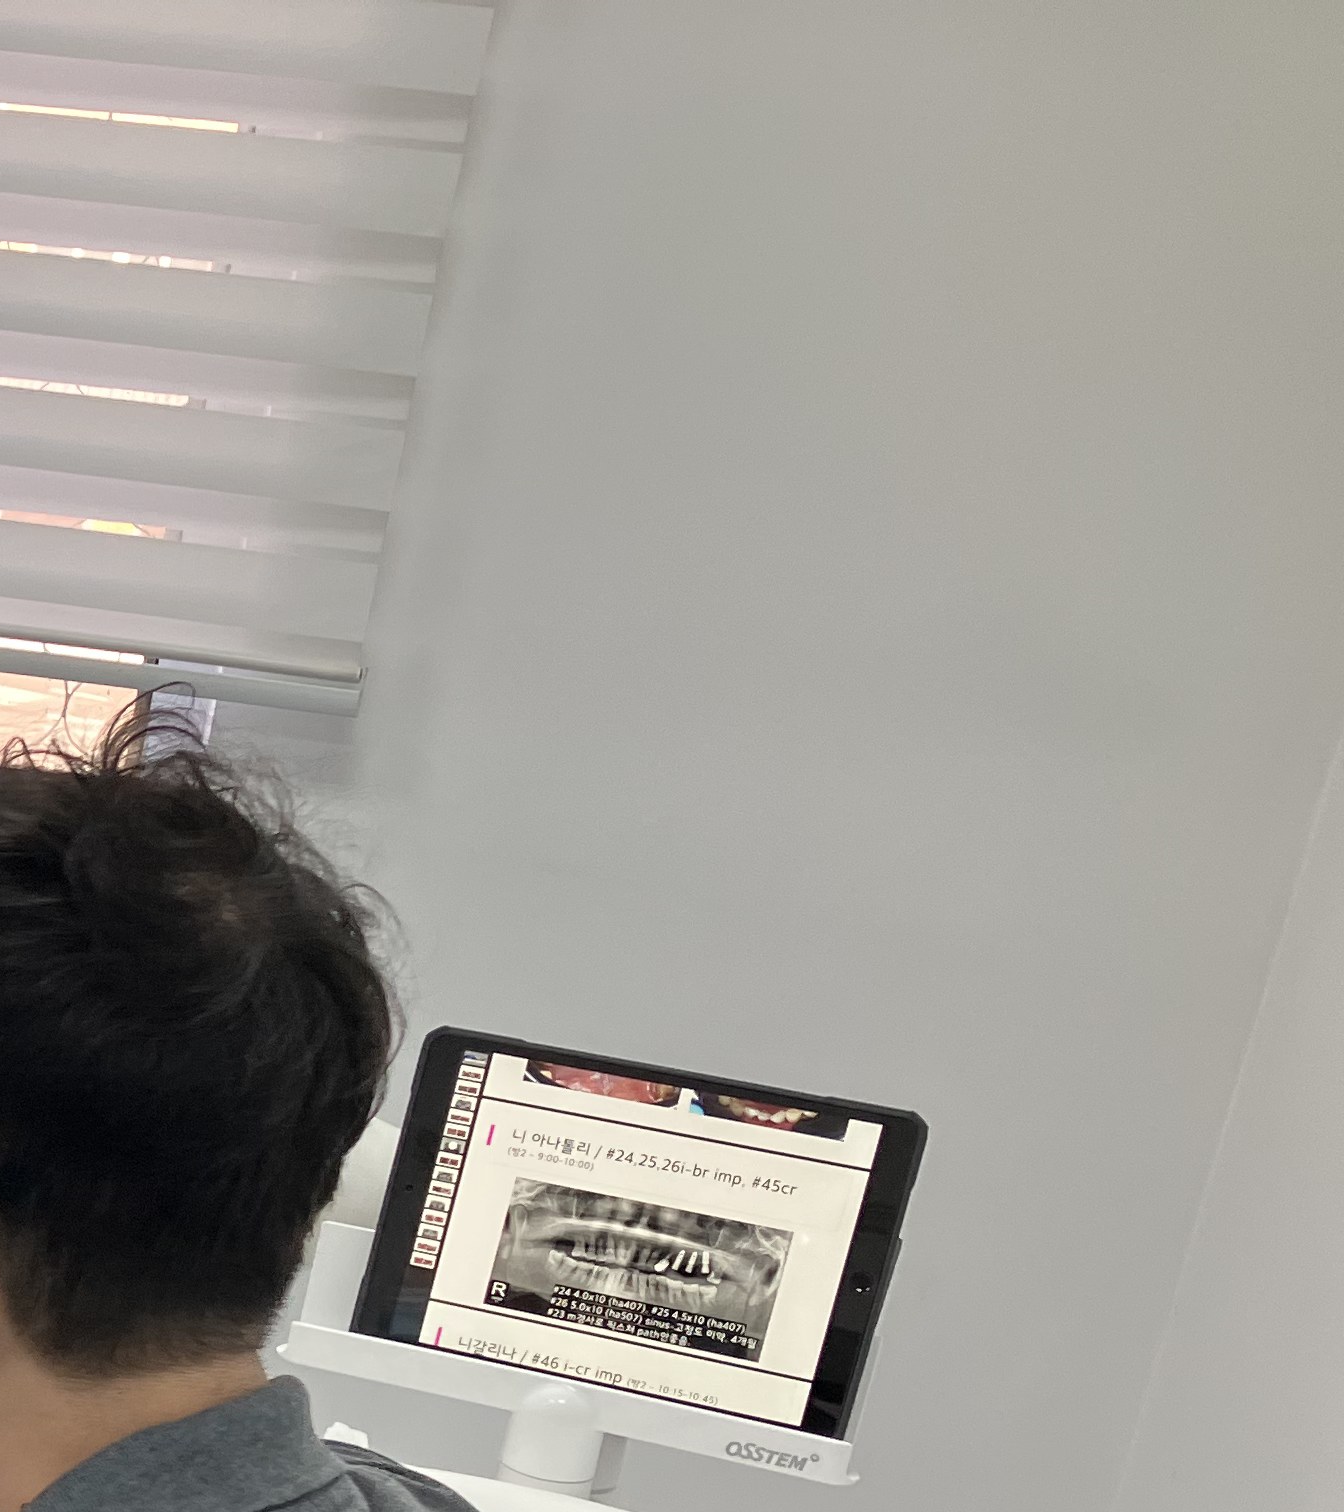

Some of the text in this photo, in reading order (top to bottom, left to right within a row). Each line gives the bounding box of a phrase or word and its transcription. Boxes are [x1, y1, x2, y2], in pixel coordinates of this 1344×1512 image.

[512, 1128, 527, 1144] 니
[531, 1133, 591, 1156] 아나톨리
[593, 1145, 603, 1160] /
[751, 1175, 798, 1196] #45cr
[490, 1281, 508, 1297] R
[573, 1289, 606, 1304] 4.0x10
[672, 1310, 705, 1325] 4.5x10
[570, 1300, 603, 1315] 5.0x10
[519, 1350, 528, 1364] /
[531, 1353, 559, 1369] #46
[563, 1360, 591, 1375] i-cr
[595, 1367, 623, 1386] imp
